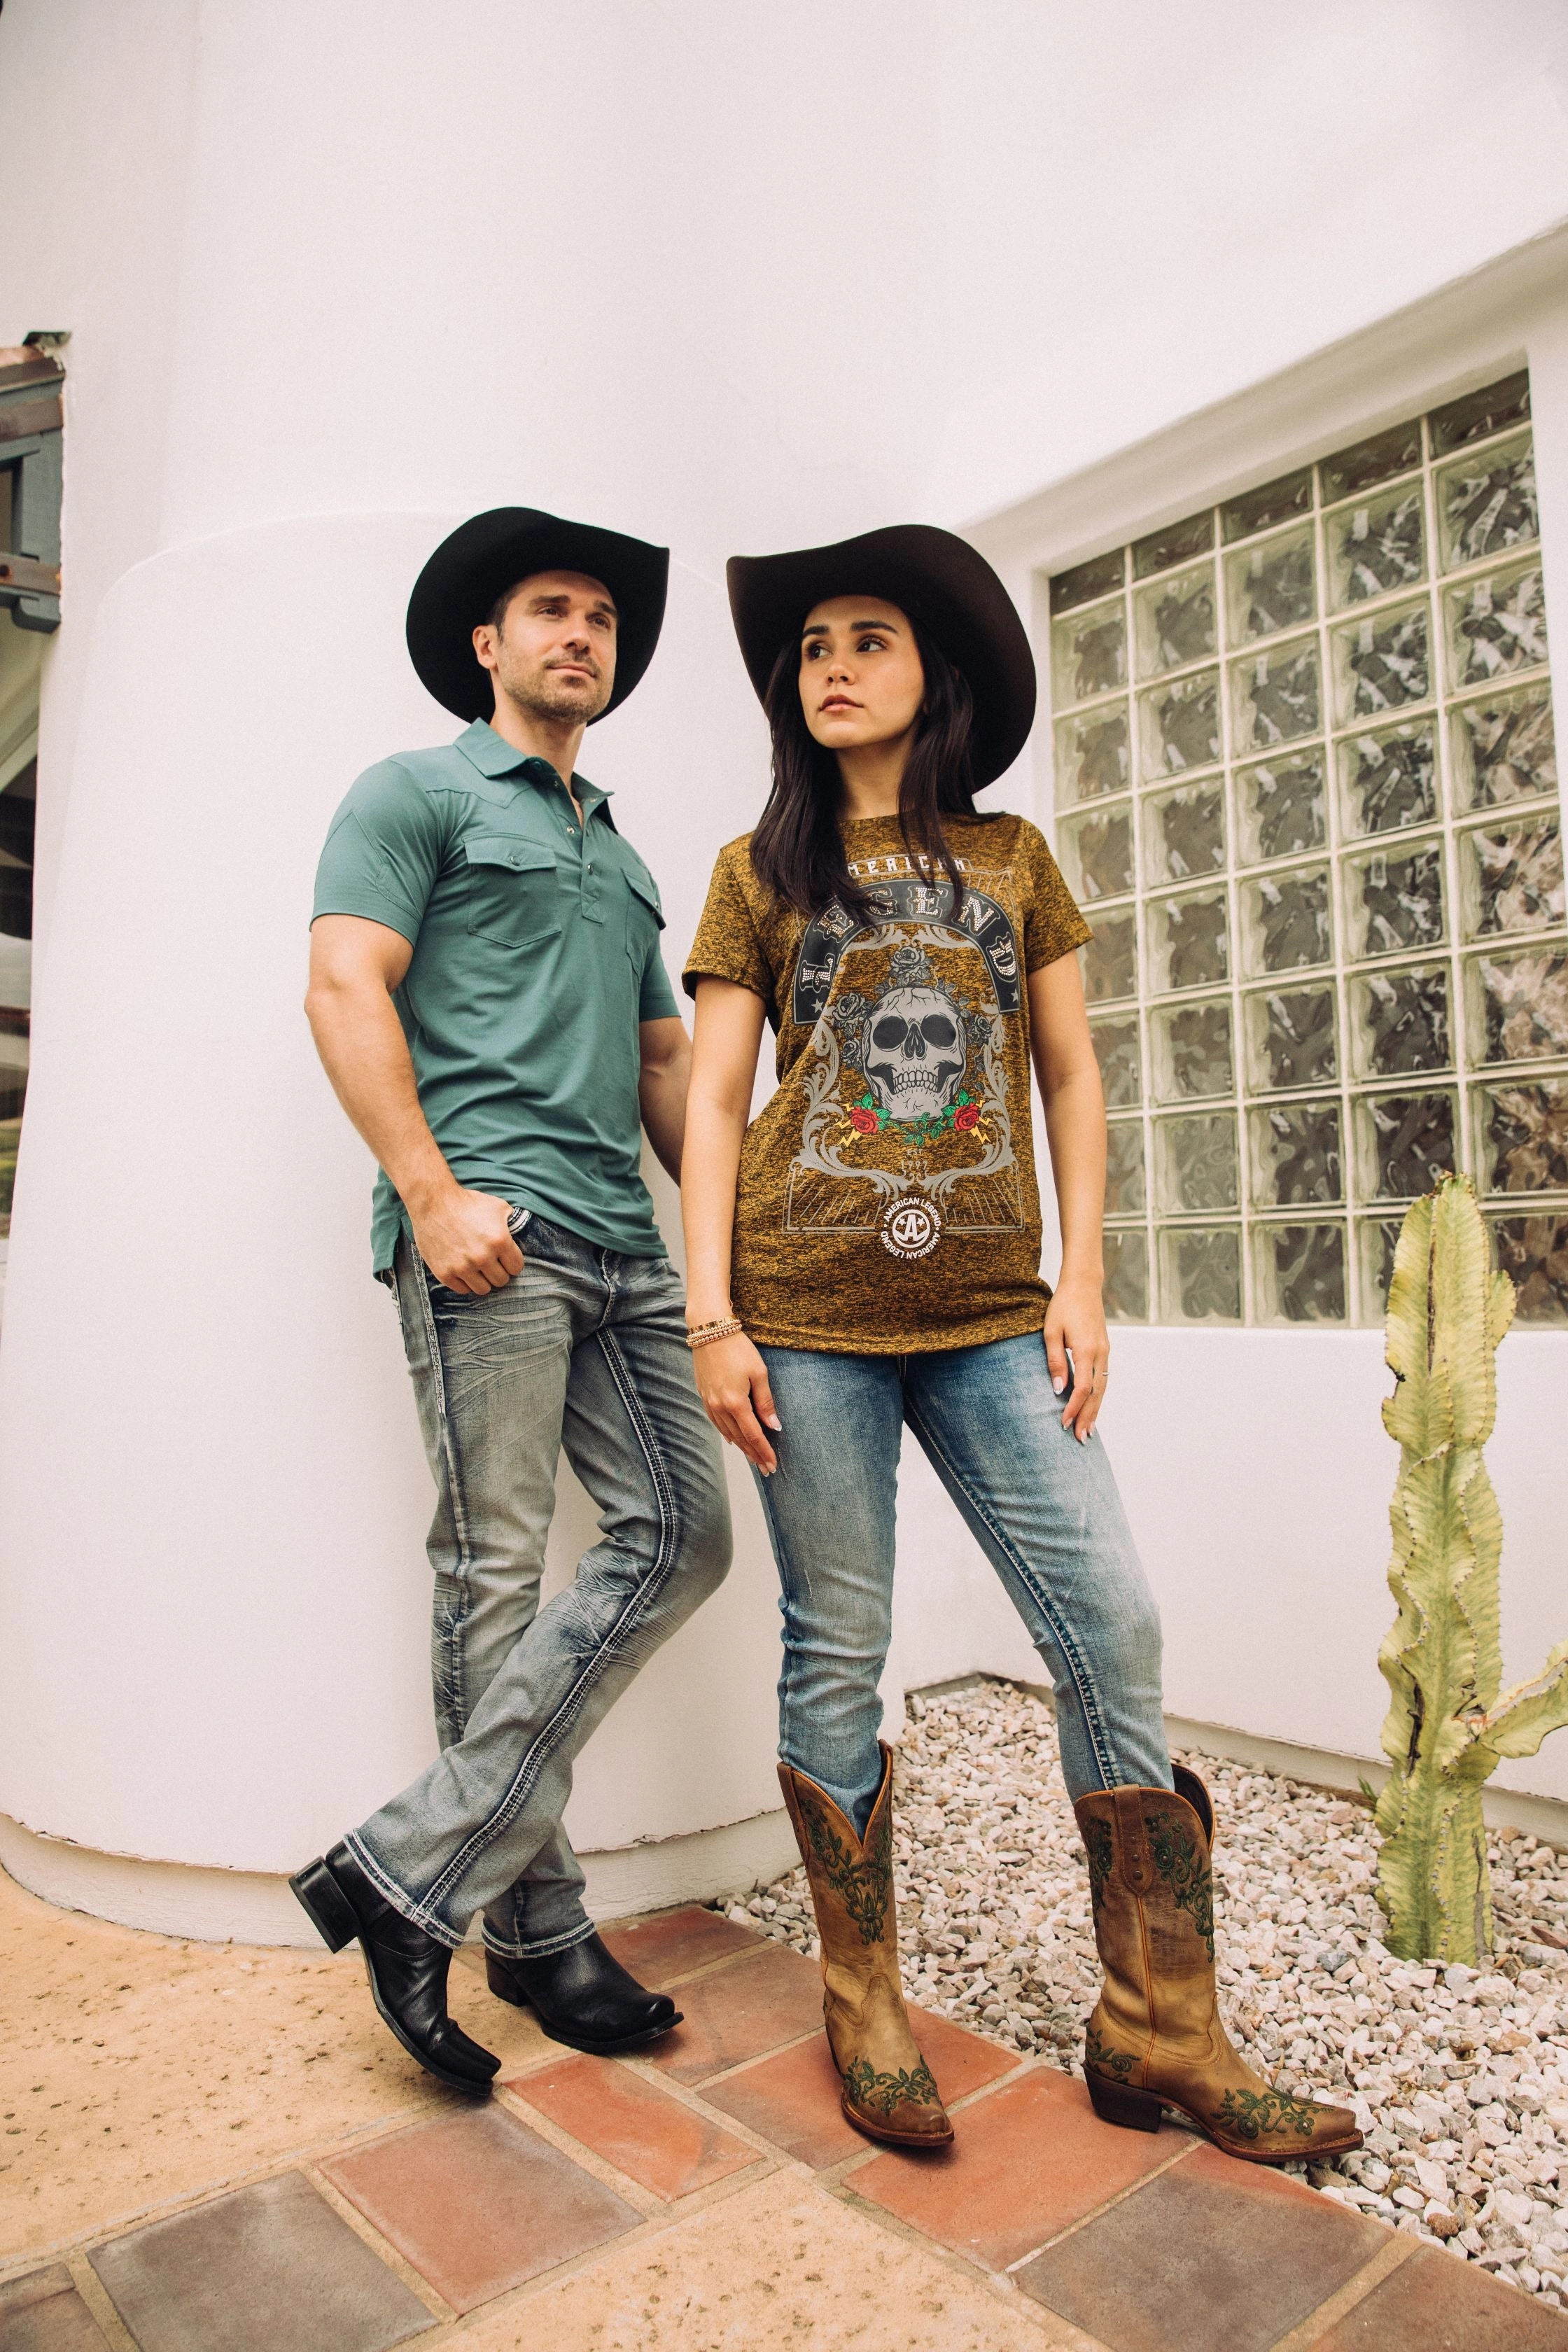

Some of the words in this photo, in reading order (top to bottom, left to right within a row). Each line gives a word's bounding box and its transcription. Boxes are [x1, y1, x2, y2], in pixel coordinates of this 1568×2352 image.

[847, 855, 965, 876] MERICN
[800, 886, 1018, 988] LEGEND
[901, 1160, 927, 1170] 1997
[883, 1196, 920, 1222] AMERICAN
[920, 1198, 941, 1226] LEGEND
[881, 1231, 905, 1259] LEGEND
[906, 1232, 940, 1259] AMERICAN
